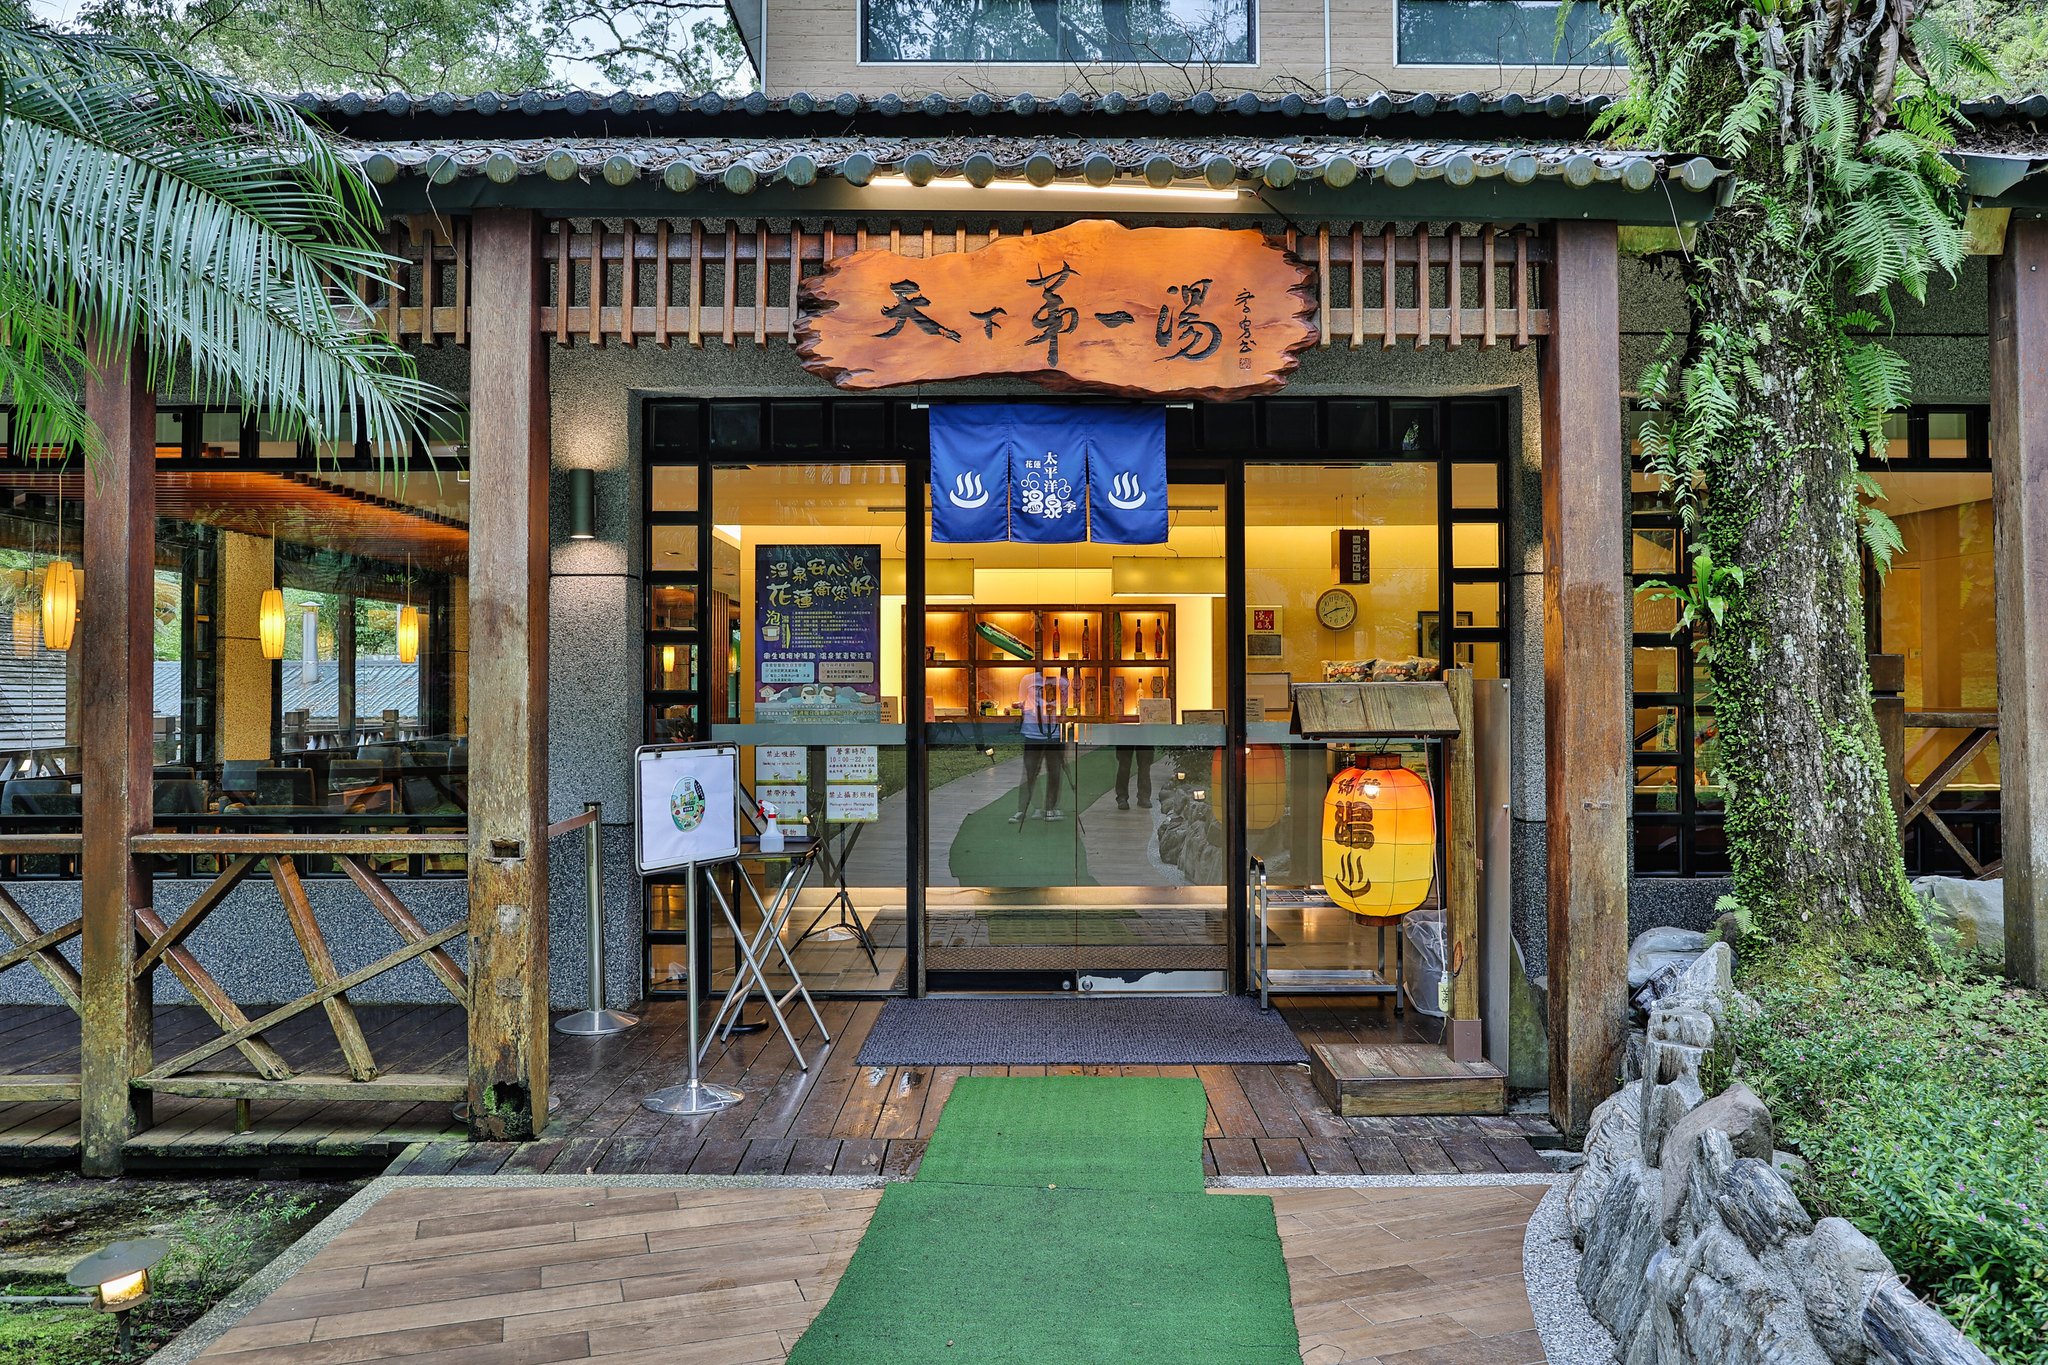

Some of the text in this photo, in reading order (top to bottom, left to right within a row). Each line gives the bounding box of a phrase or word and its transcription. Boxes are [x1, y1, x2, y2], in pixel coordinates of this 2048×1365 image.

[871, 260, 1223, 367] 天下第一湯
[1025, 460, 1042, 469] 花蓮
[1043, 451, 1059, 493] 太平洋
[770, 555, 863, 583] 溫泉安心包
[766, 575, 874, 607] 花蓮衛您好
[835, 747, 867, 755] 營業時間
